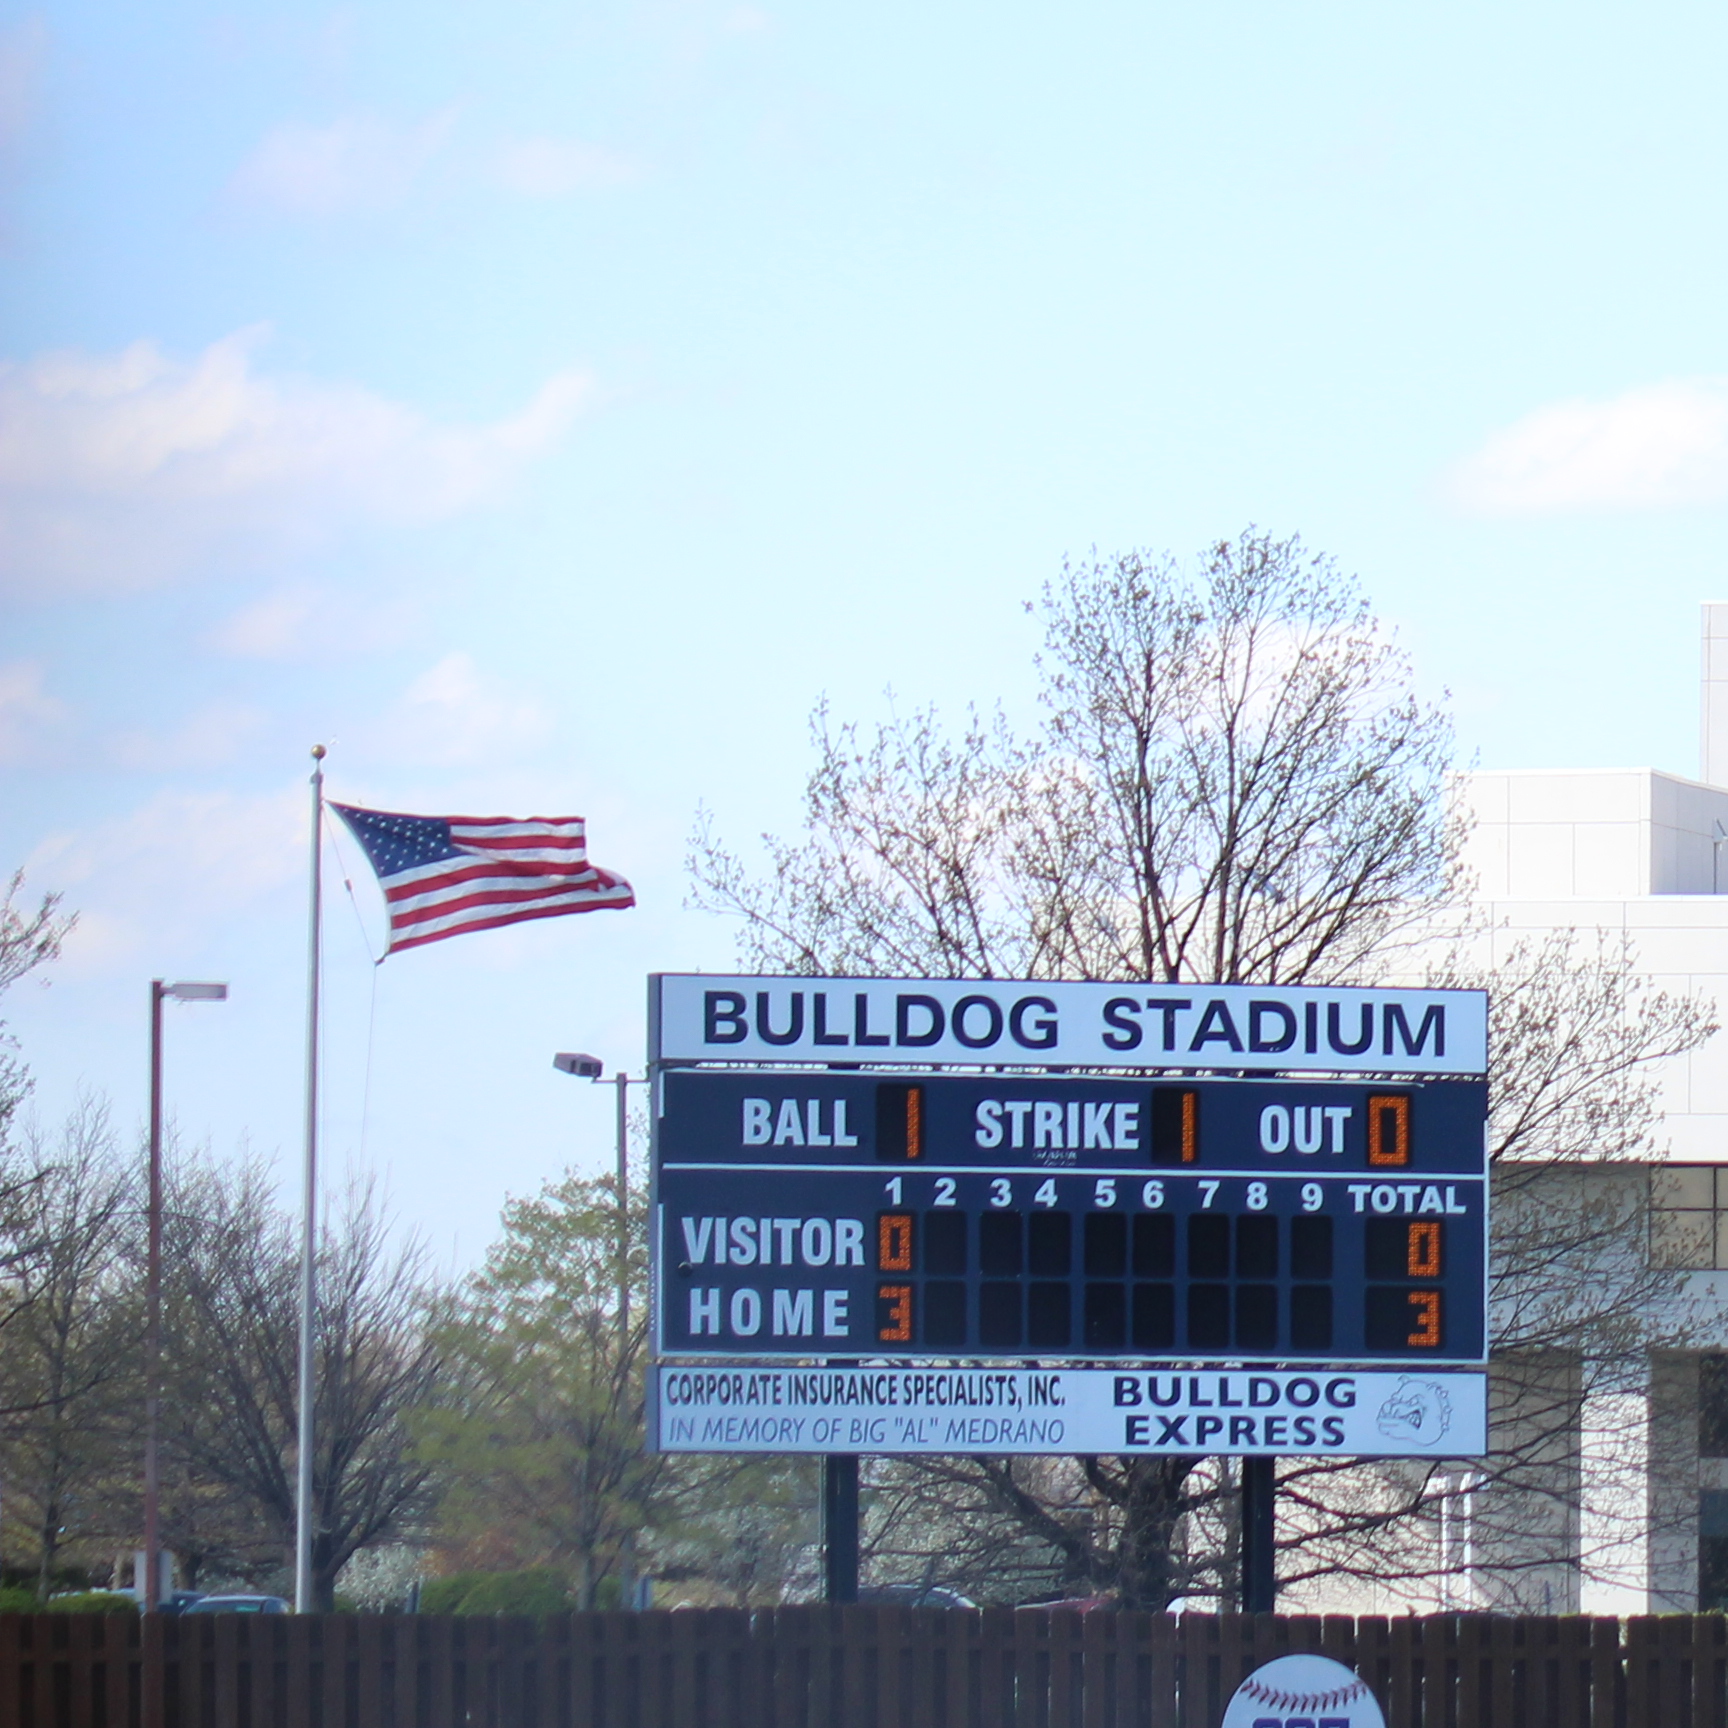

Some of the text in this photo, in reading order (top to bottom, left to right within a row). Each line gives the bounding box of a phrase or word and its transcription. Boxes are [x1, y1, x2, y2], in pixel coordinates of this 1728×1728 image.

[703, 990, 1446, 1056] BULLDOG STADIUM
[743, 1088, 1409, 1166] BALL 1 STRIKE 1 OUT 0
[884, 1177, 1467, 1214] 1 2 3 4 5 6 7 8 9 TOTAL
[681, 1215, 1440, 1277] VISITOR 0 0
[689, 1287, 850, 1337] HOME
[879, 1286, 912, 1341] 3
[1407, 1291, 1440, 1346] 3
[666, 1373, 1066, 1412] CORPORATE INSURANCE SPECIALISTS, INC.
[1113, 1376, 1357, 1409] BULLDOG
[669, 1417, 1065, 1445] IN MEMORY OF BIG "AL" MEDRANO
[1124, 1415, 1346, 1447] EXPRESS
